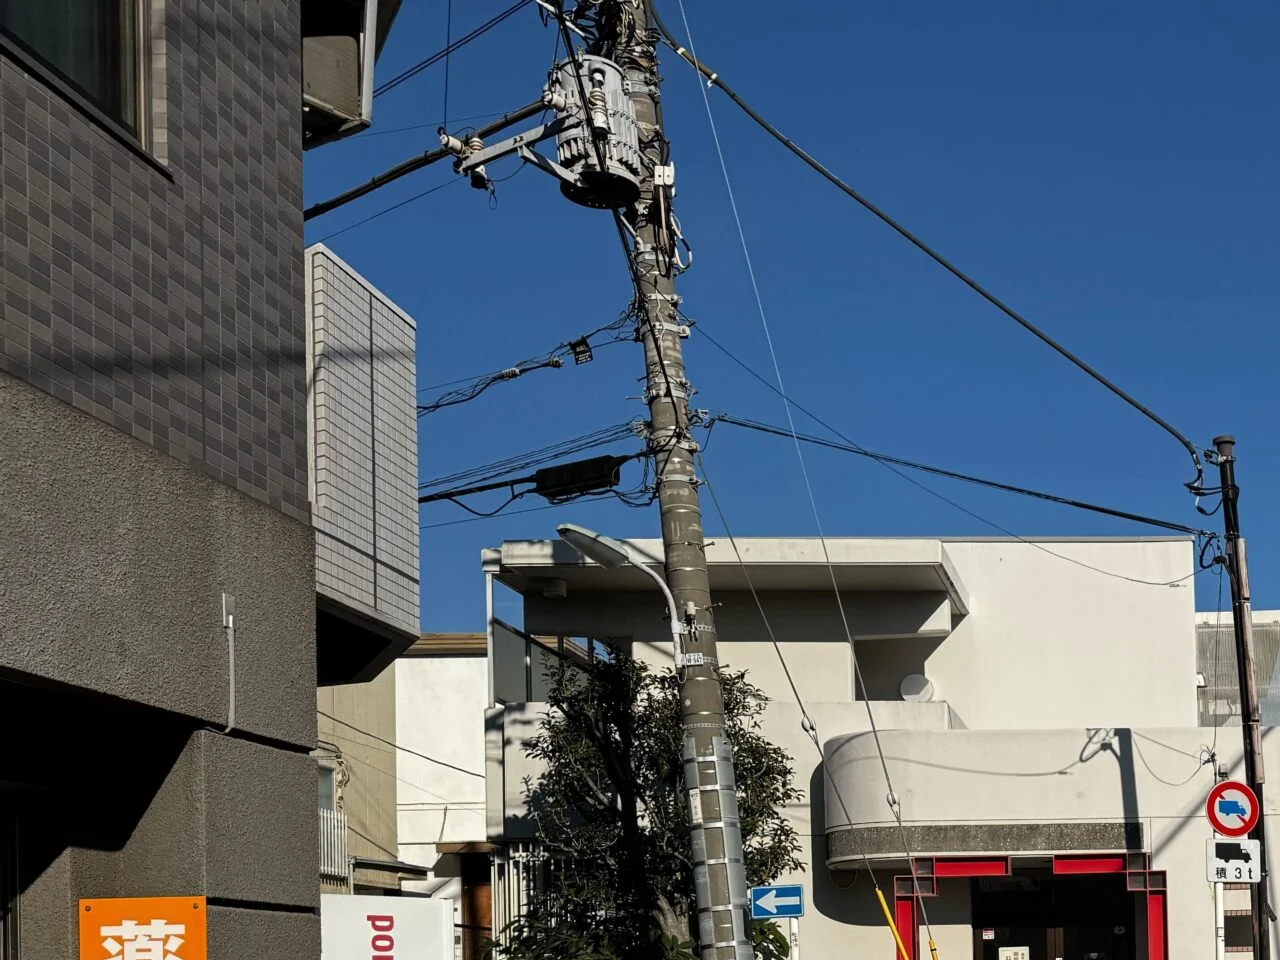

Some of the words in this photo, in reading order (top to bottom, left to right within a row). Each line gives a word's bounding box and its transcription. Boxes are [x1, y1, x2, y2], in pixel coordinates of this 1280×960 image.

[1215, 867, 1227, 879] 積
[1235, 867, 1242, 879] 3
[1248, 867, 1253, 879] t
